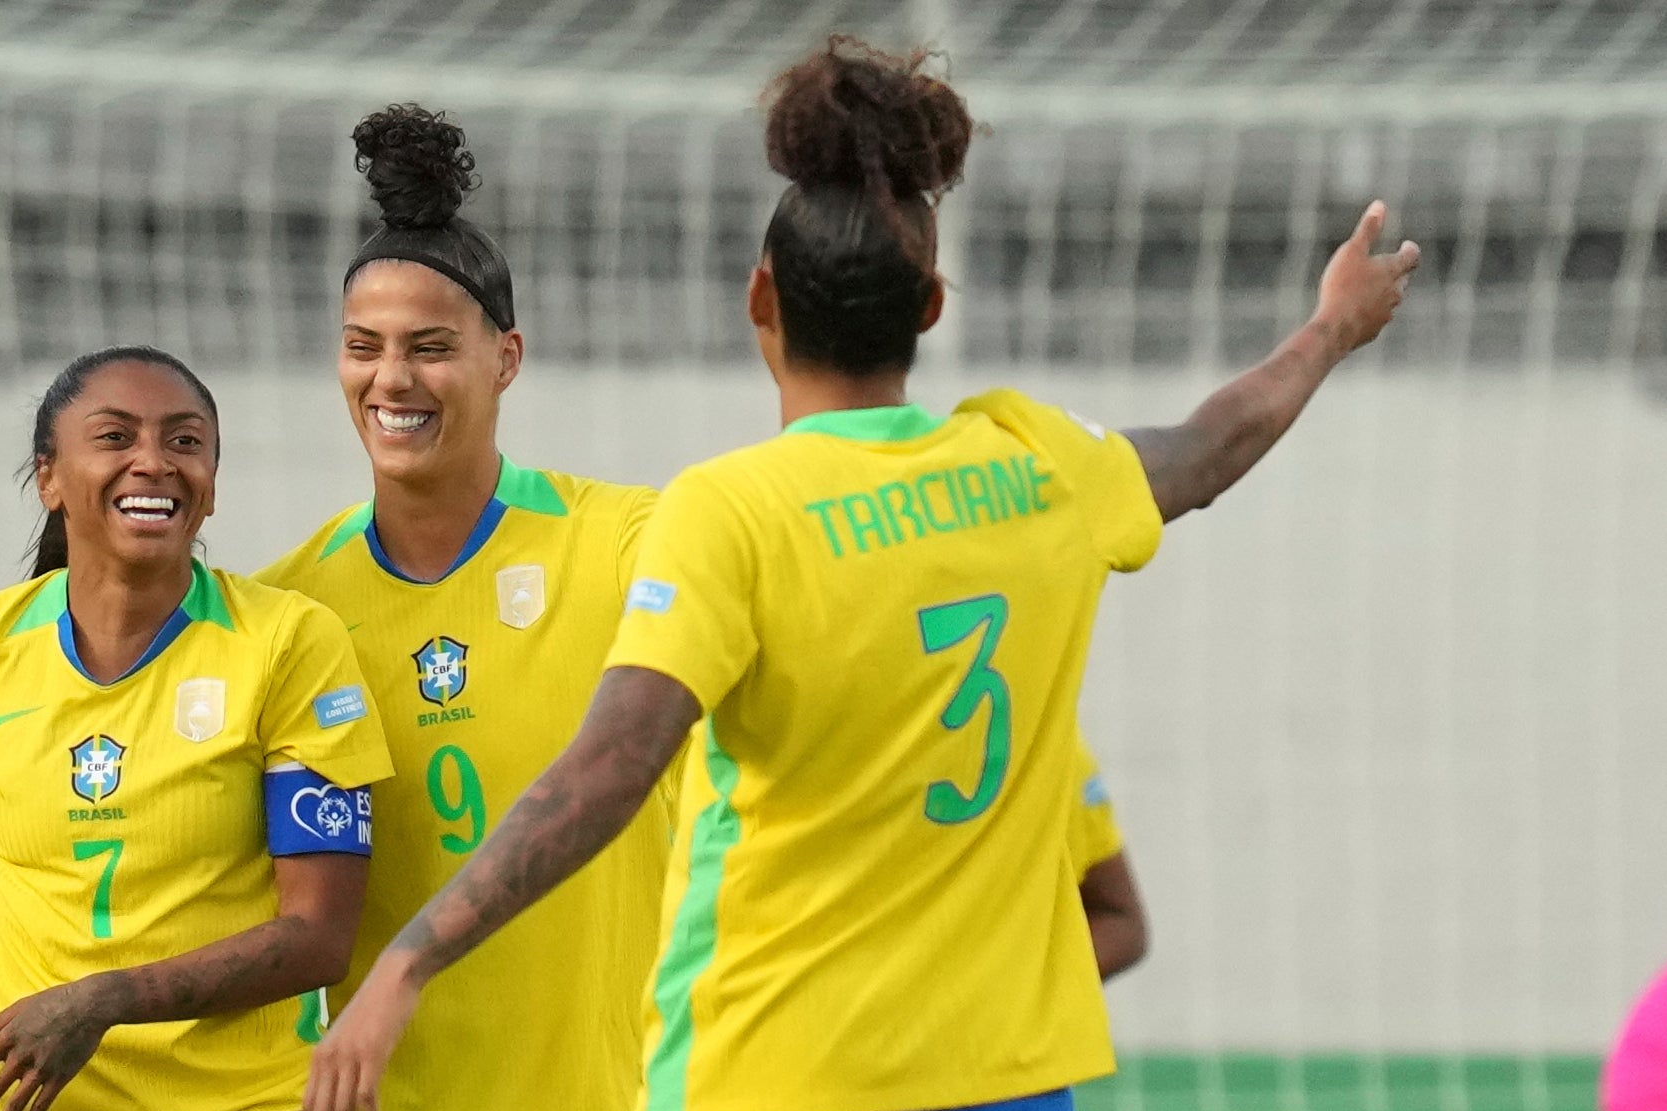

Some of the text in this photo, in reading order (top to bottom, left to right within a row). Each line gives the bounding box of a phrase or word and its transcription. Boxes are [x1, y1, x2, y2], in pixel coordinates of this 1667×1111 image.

[805, 456, 1053, 558] TARCIANE
[432, 664, 453, 675] CBF
[417, 706, 475, 727] BRASIL
[917, 592, 1012, 825] 3
[87, 762, 109, 772] CBF
[67, 807, 127, 822] BRASIL
[425, 744, 486, 854] 9
[72, 839, 124, 939] 7
